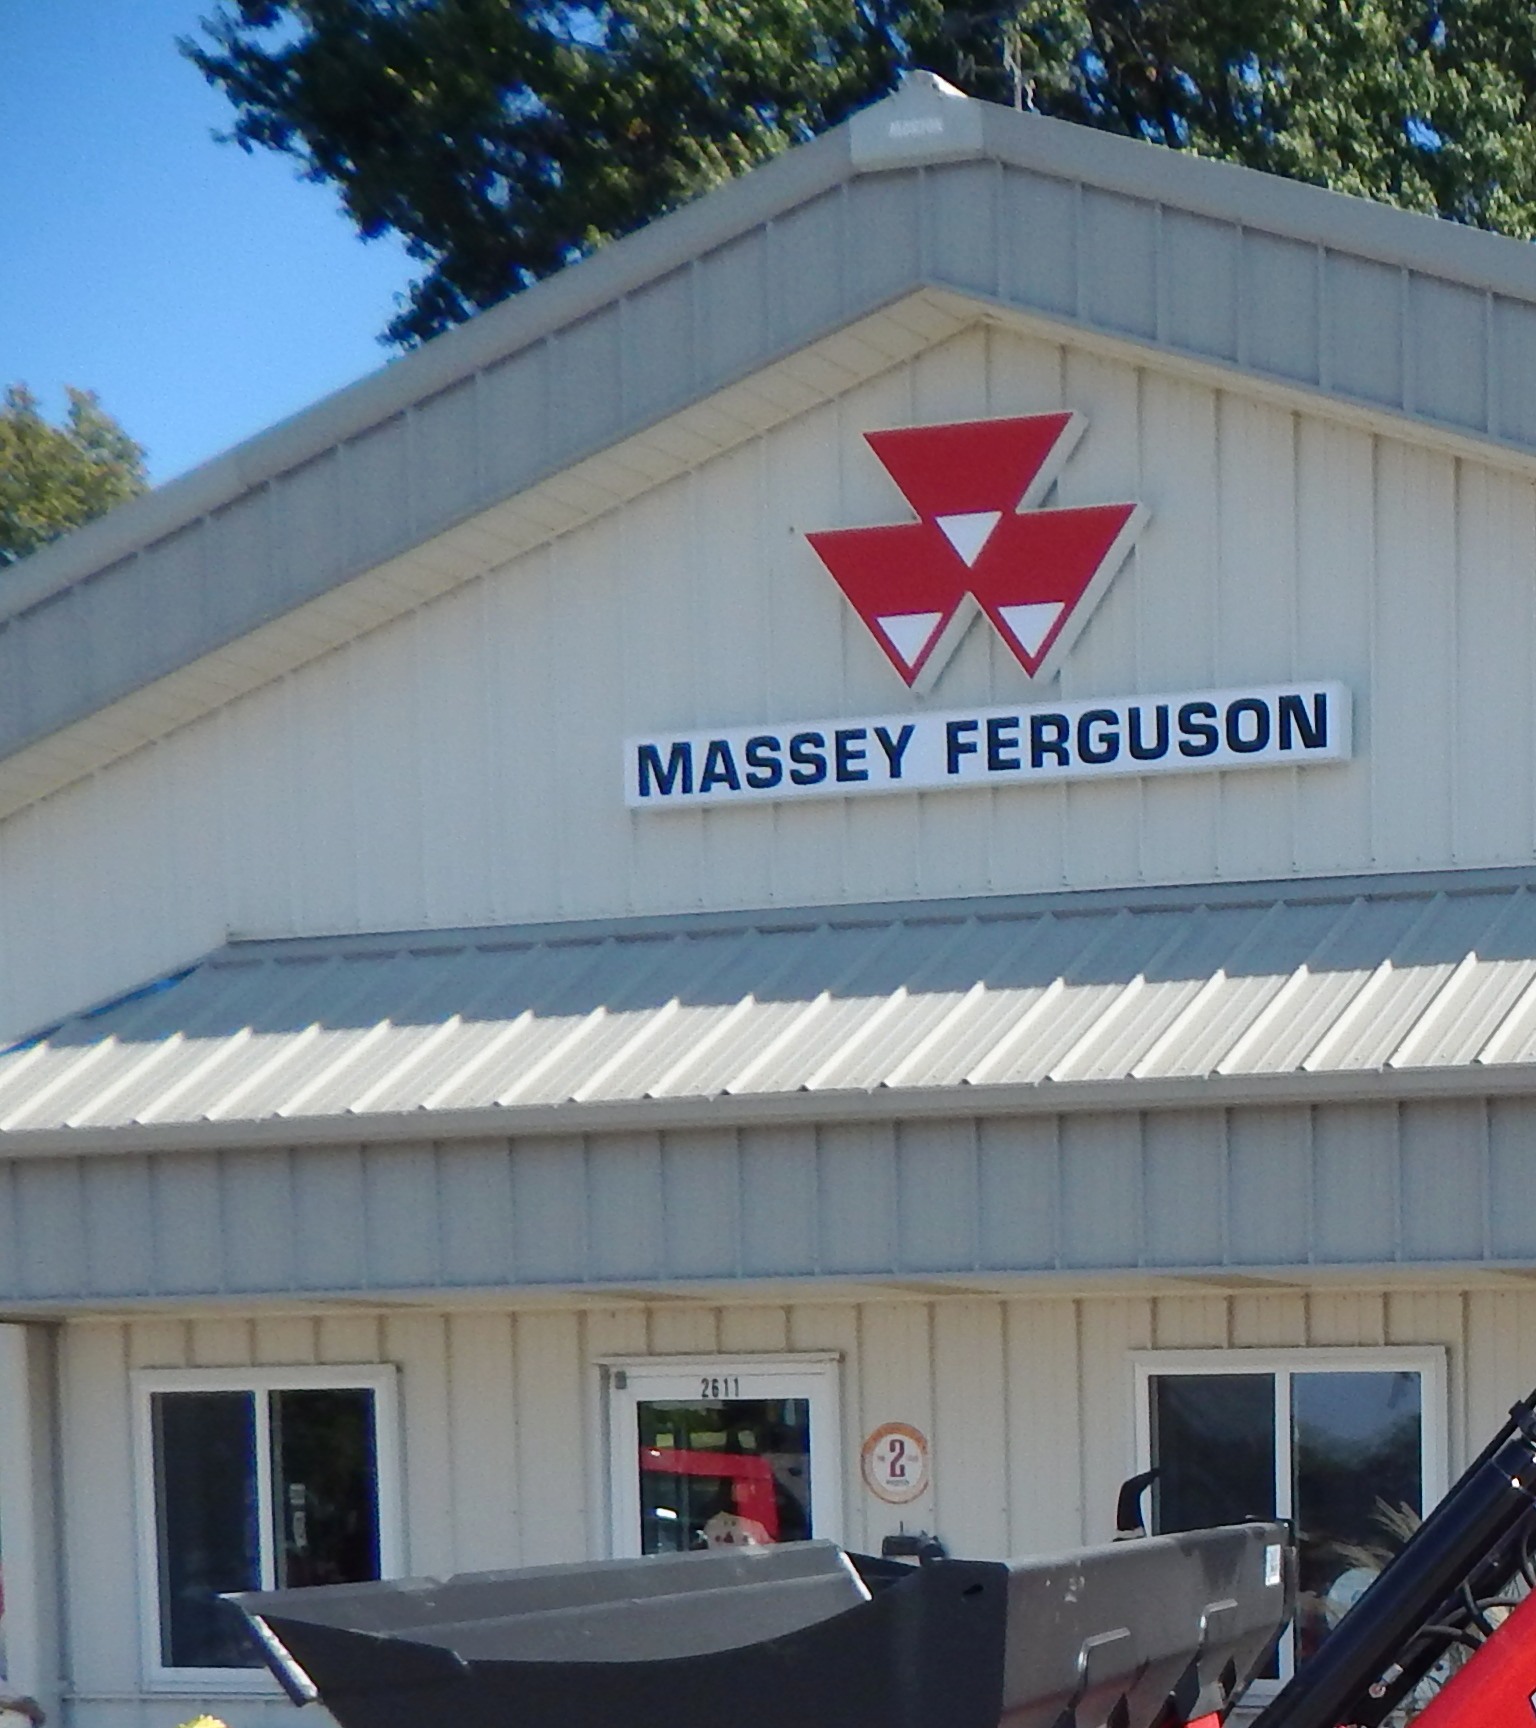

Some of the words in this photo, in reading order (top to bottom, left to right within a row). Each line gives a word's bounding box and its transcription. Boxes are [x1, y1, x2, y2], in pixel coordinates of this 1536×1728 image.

[637, 725, 915, 797] MASSEY
[947, 693, 1328, 775] FERGUSON
[701, 1377, 739, 1398] 2611
[889, 1438, 906, 1478] 2
